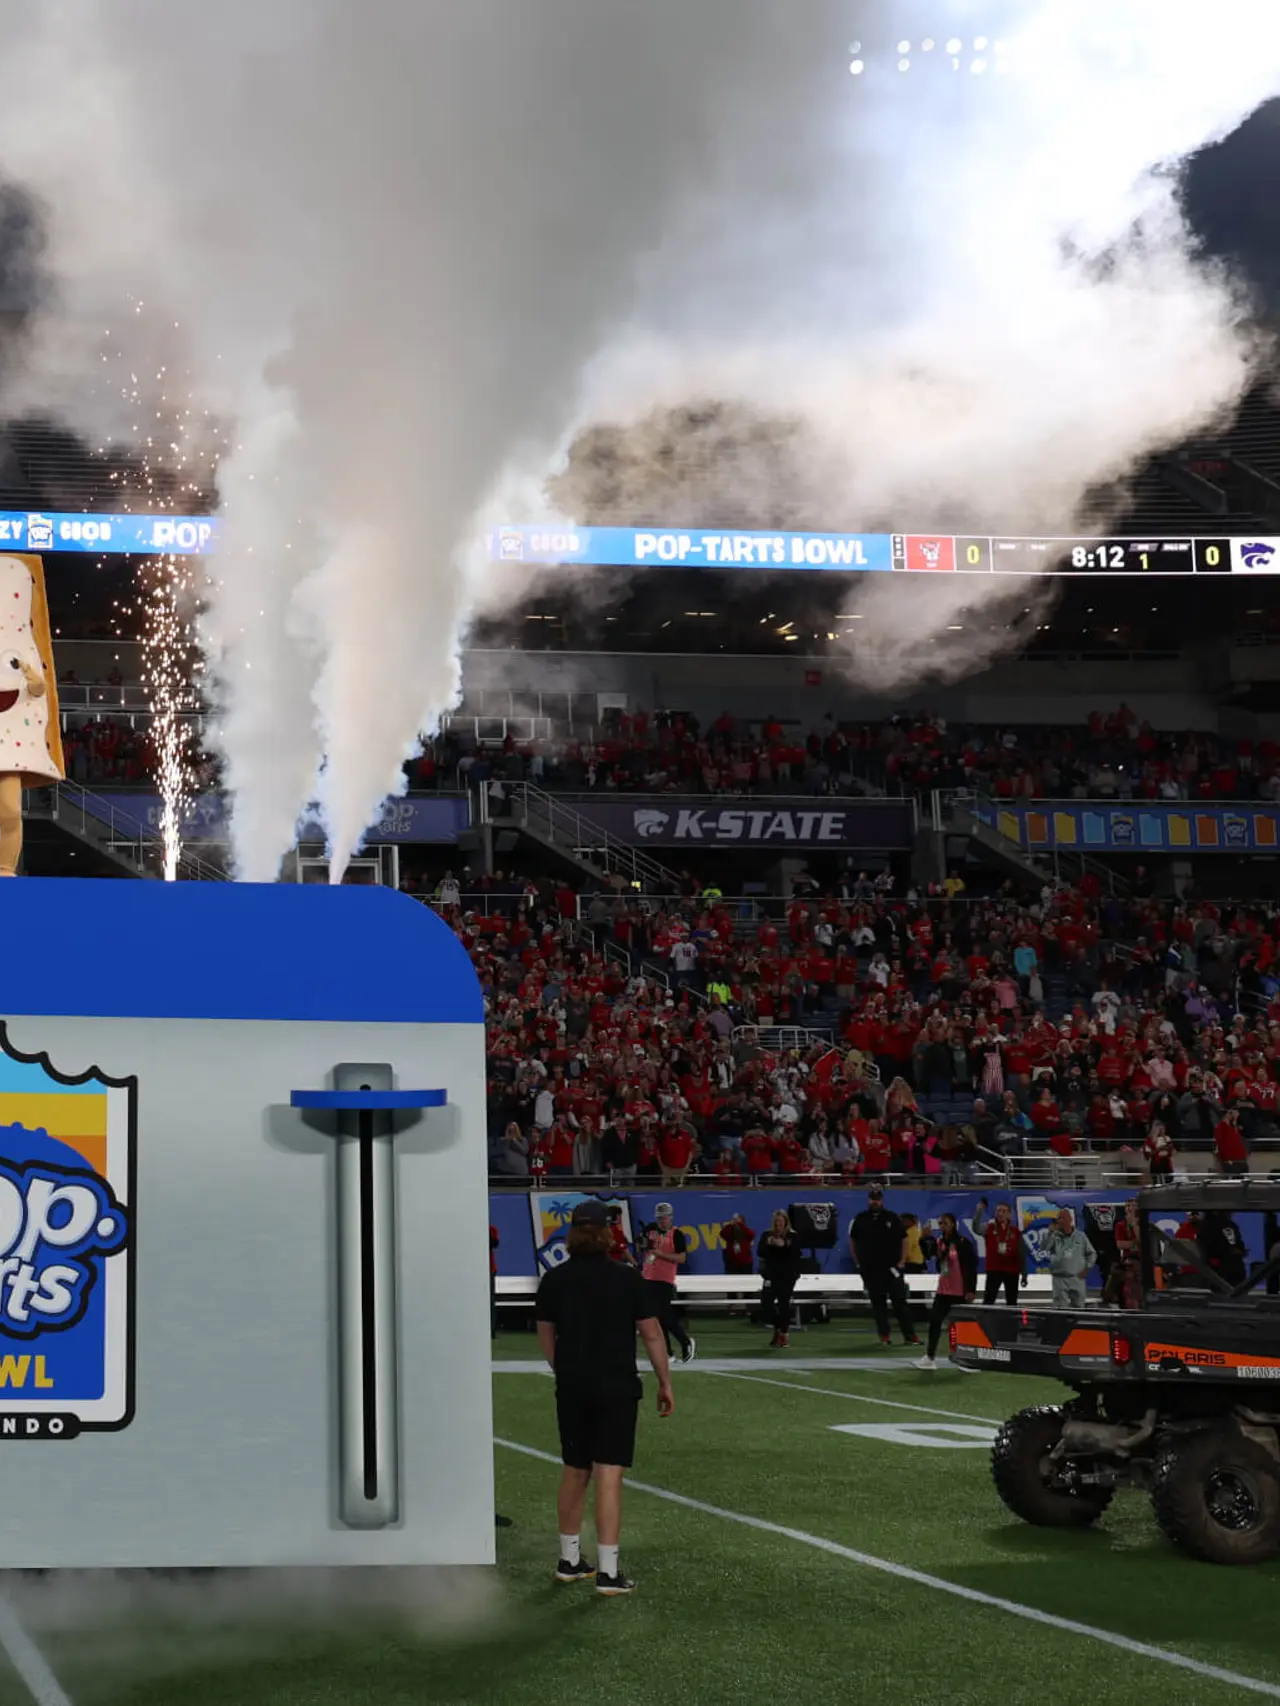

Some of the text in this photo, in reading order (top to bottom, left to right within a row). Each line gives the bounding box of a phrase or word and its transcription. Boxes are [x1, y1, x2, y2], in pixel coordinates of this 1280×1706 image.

[634, 533, 868, 565] POP-TARTS BOWL
[966, 545, 980, 565] 0
[1071, 545, 1125, 569] 8:12
[1205, 545, 1220, 566] 0
[1139, 553, 1149, 570] 1
[673, 809, 846, 841] K-STATE
